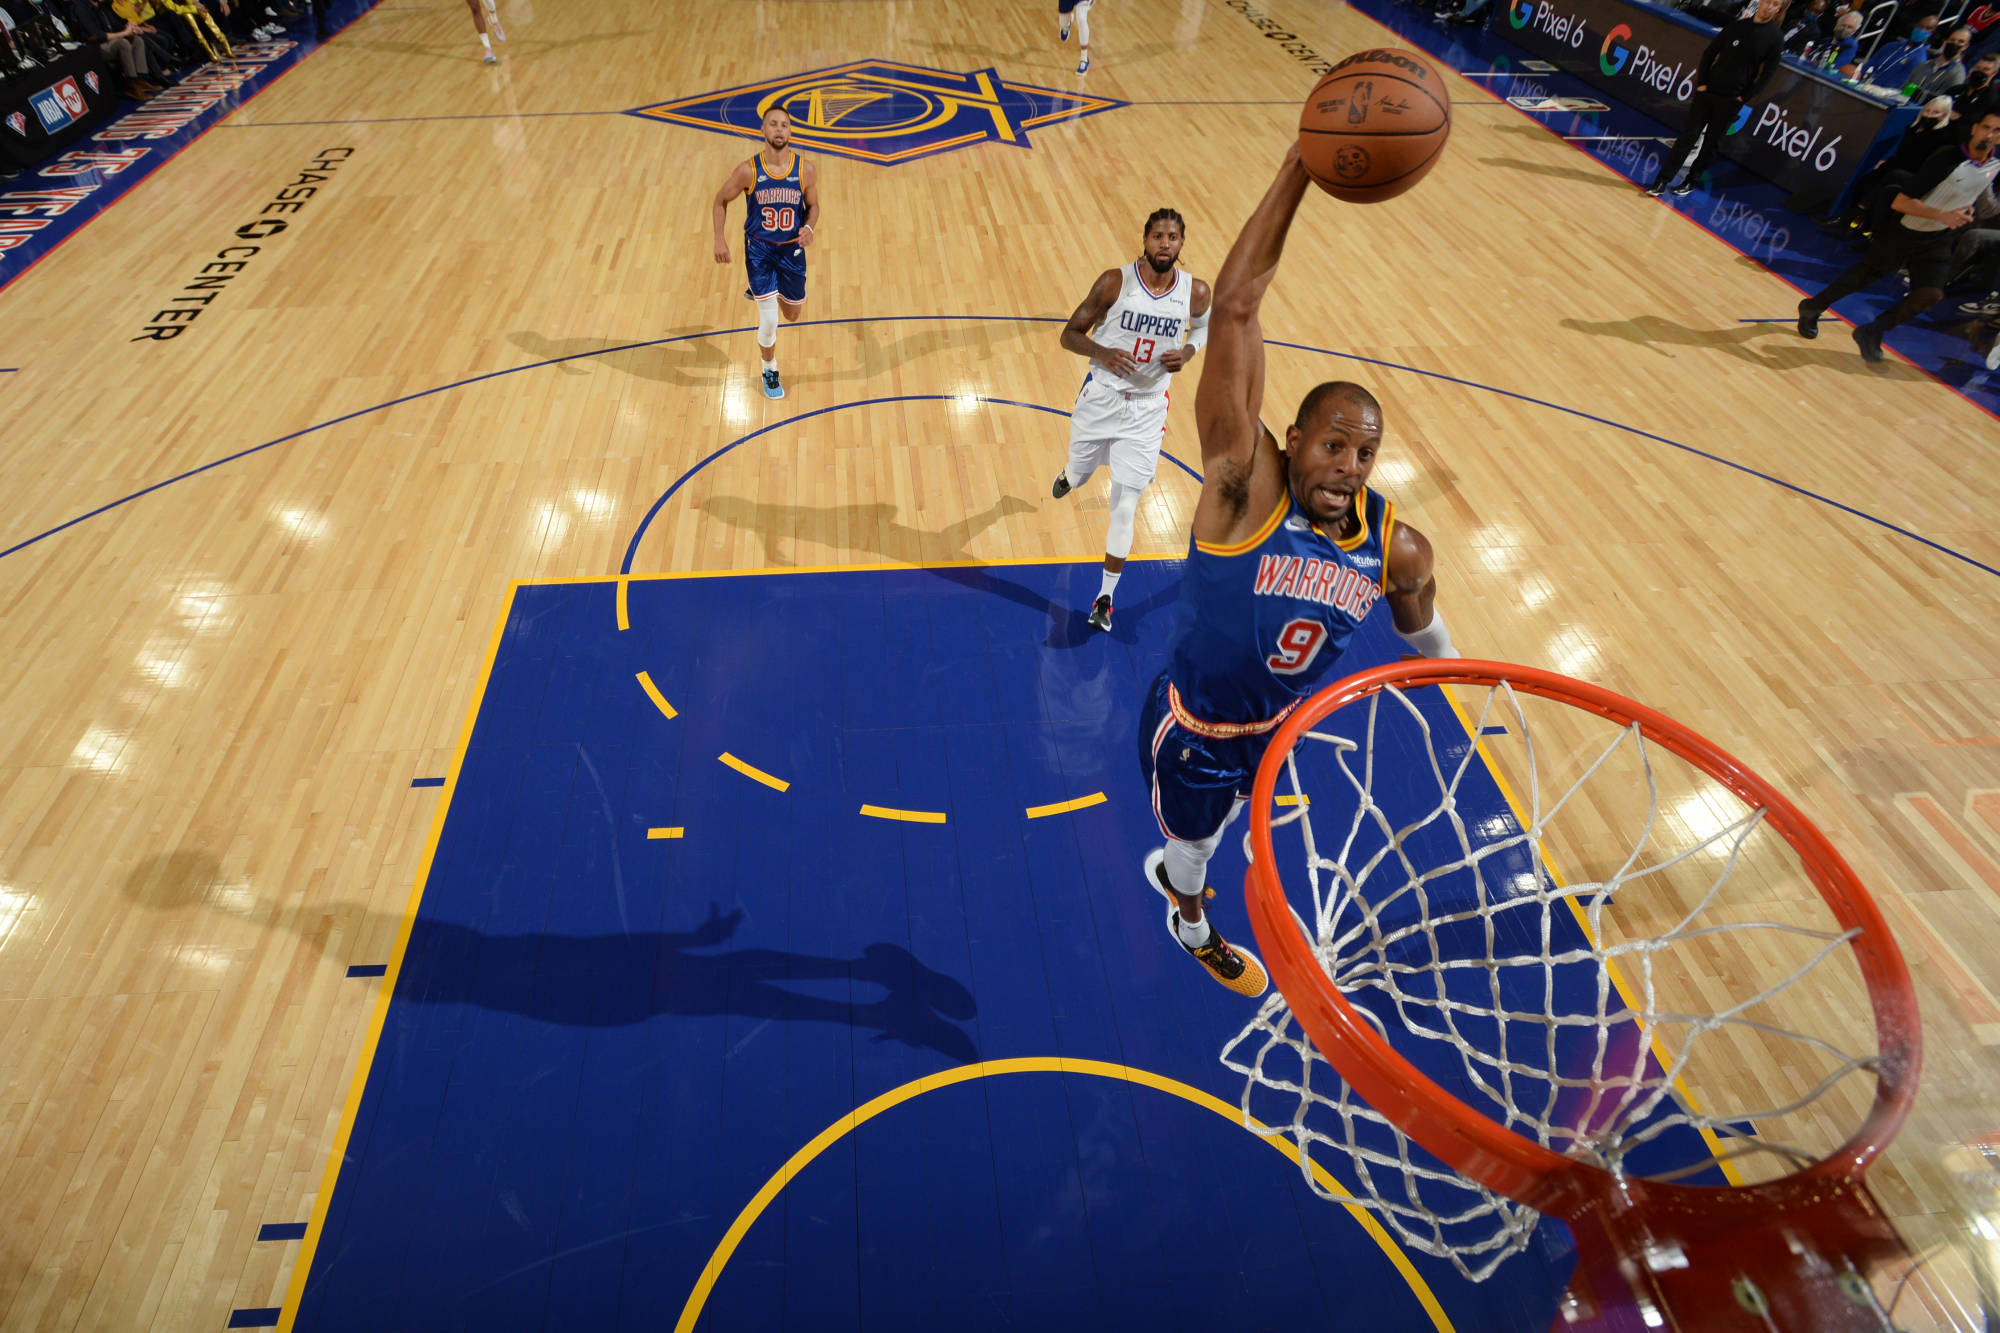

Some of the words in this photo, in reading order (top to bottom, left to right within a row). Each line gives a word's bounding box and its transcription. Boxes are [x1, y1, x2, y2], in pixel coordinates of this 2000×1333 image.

[1533, 1, 1576, 42] Pixel
[1571, 19, 1587, 48] 6
[1280, 43, 1332, 76] CENTE
[1629, 45, 1682, 94] Pixel
[1677, 69, 1697, 101] 6
[1753, 102, 1823, 161] Pixel
[1815, 135, 1842, 171] 6
[38, 147, 152, 176] 75
[260, 147, 355, 214] CHASE
[756, 187, 802, 205] WARRIORS
[761, 207, 795, 231] 30
[130, 246, 261, 342] CENTER
[1120, 310, 1181, 337] CLIPPERS
[1132, 337, 1156, 363] 13
[1254, 554, 1382, 622] WARRIORS
[1266, 618, 1328, 675] 9
